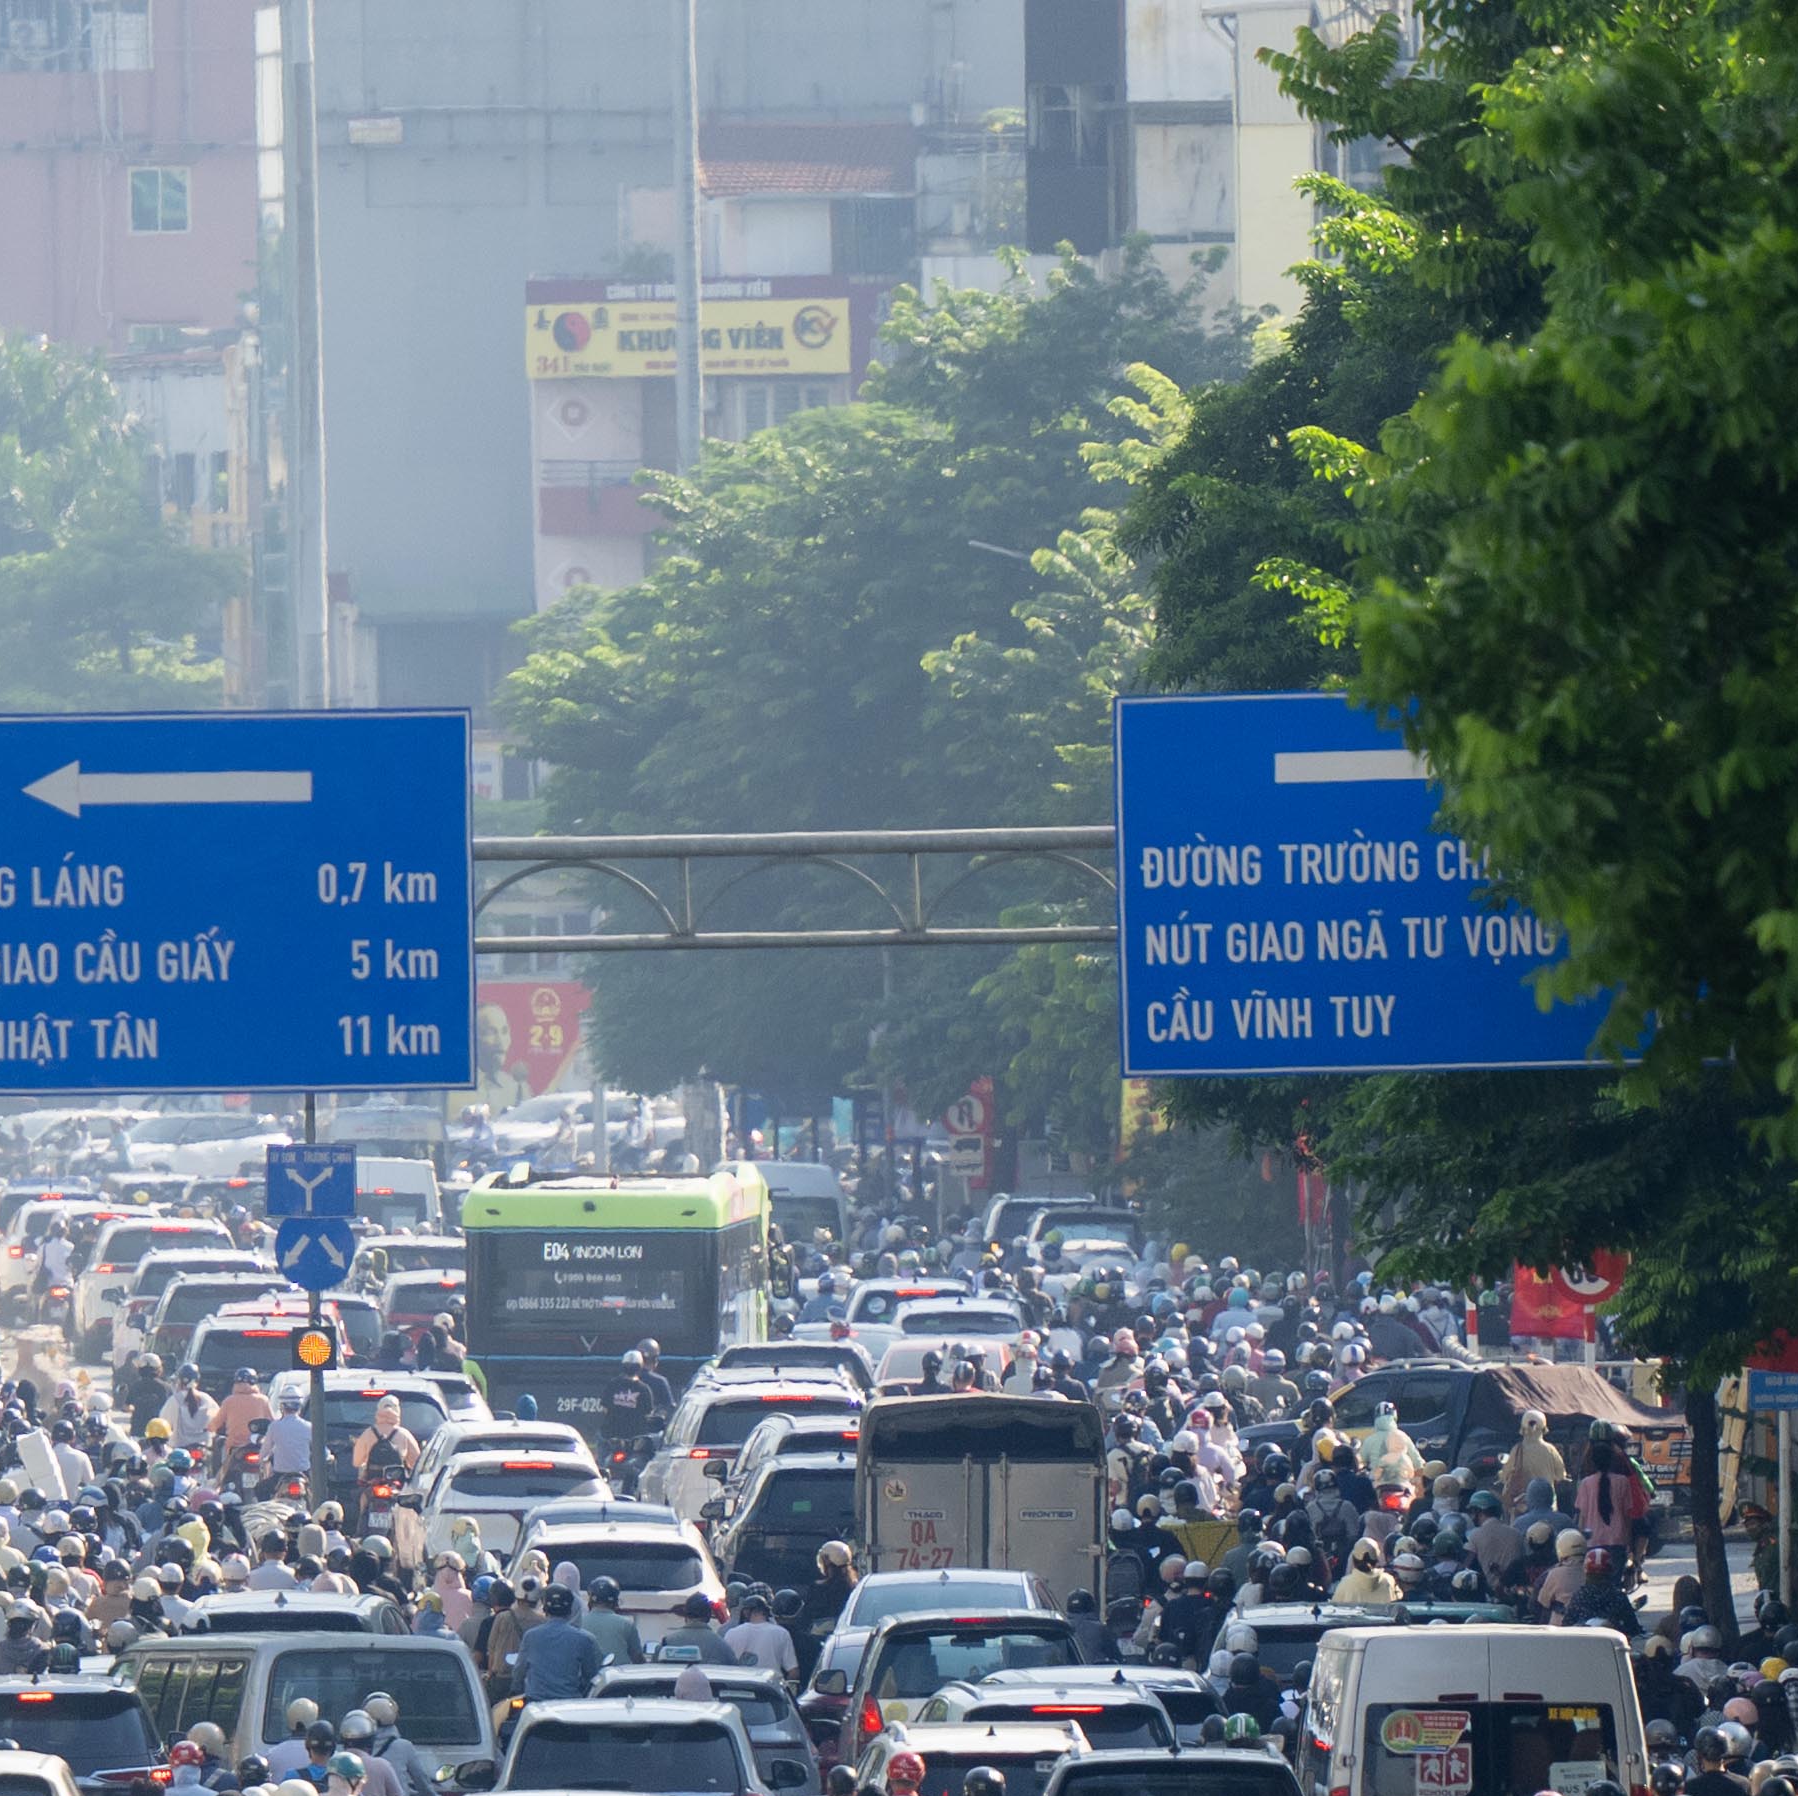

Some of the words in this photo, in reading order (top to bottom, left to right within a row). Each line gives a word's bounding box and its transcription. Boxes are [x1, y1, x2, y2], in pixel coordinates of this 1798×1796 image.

[32, 852, 123, 907] LÁNG
[1140, 833, 1261, 888] ĐƯỜNG
[1279, 829, 1419, 884] TRƯỜNG
[318, 862, 367, 905] 0,7
[384, 862, 436, 903] km
[75, 929, 140, 983] CẦU
[158, 926, 234, 982] GIẤY
[352, 940, 370, 979] 5
[385, 939, 438, 978] km
[1146, 911, 1212, 965] NÚT
[1227, 922, 1304, 962] GIAO
[1318, 910, 1387, 960] NGÃ
[1402, 916, 1447, 958] TƯ
[91, 1012, 157, 1058] TÂN
[339, 1016, 370, 1055] 11
[388, 1015, 440, 1055] km
[1147, 987, 1213, 1042] CẦU
[1232, 990, 1312, 1039] VĨNH
[1330, 995, 1395, 1037] TUY
[543, 1242, 570, 1261] E04
[911, 1520, 937, 1544] QA
[1022, 1511, 1073, 1519] FRONTIER
[898, 1549, 953, 1570] 74-27
